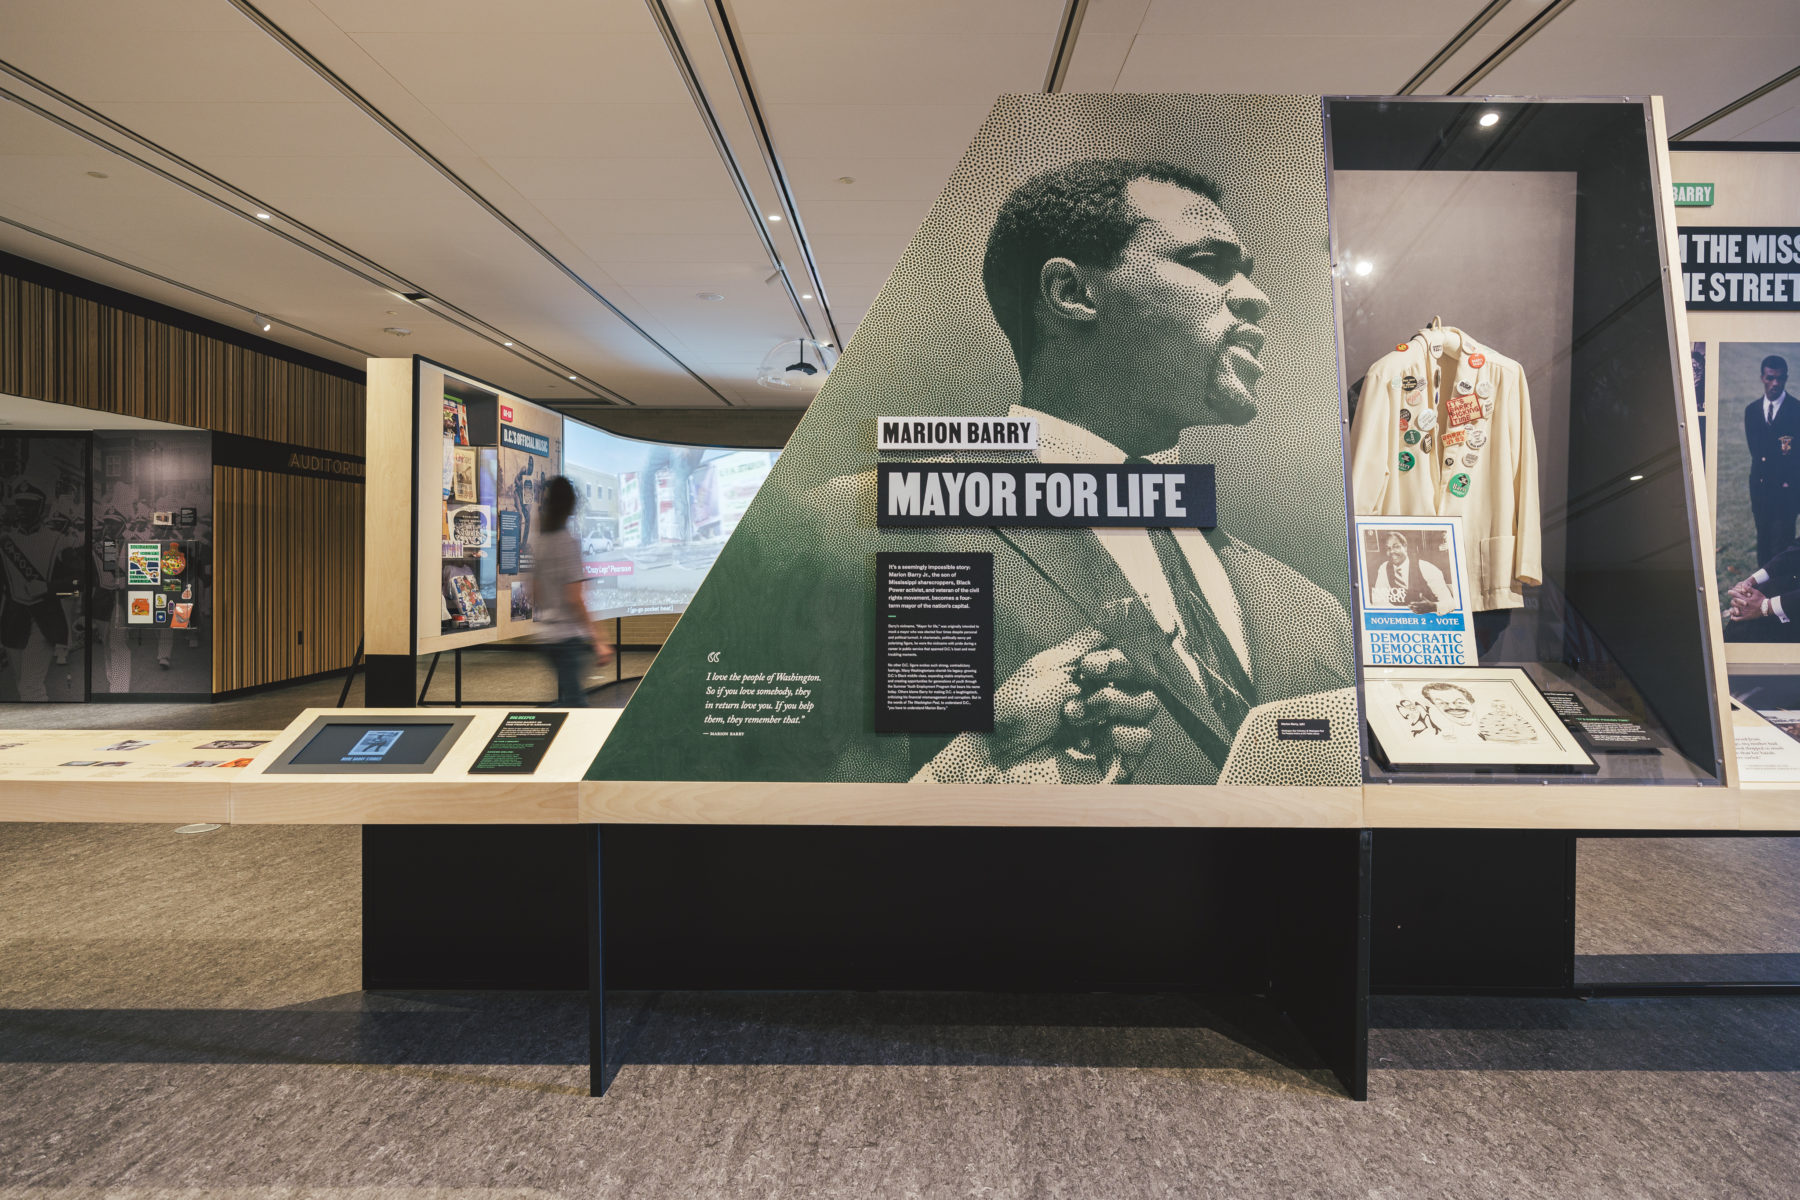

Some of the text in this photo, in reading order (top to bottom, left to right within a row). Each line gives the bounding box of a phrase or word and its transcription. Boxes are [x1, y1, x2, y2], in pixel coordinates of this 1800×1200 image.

[1672, 186, 1711, 201] BARRY
[1692, 234, 1741, 263] THE
[883, 422, 1031, 444] MARION BARRY
[288, 452, 366, 476] AUDITORIU
[888, 472, 1187, 517] MAYOR FOR LIFE
[1370, 632, 1462, 644] DEMOCRATIC
[1371, 644, 1464, 654] DEMOCRATIC
[1372, 654, 1465, 665] DEMOCRATIC
[706, 672, 821, 684] I love the people of Washington.
[706, 686, 715, 694] So
[717, 687, 725, 698] if
[740, 687, 755, 695] love
[756, 687, 793, 698] somebody,
[795, 687, 811, 698] they
[705, 701, 713, 709] in
[741, 701, 756, 709] love
[757, 704, 773, 712] you.
[775, 701, 784, 712] If
[782, 704, 797, 712] you
[798, 701, 814, 712] help
[704, 715, 806, 726] them, they remember that."
